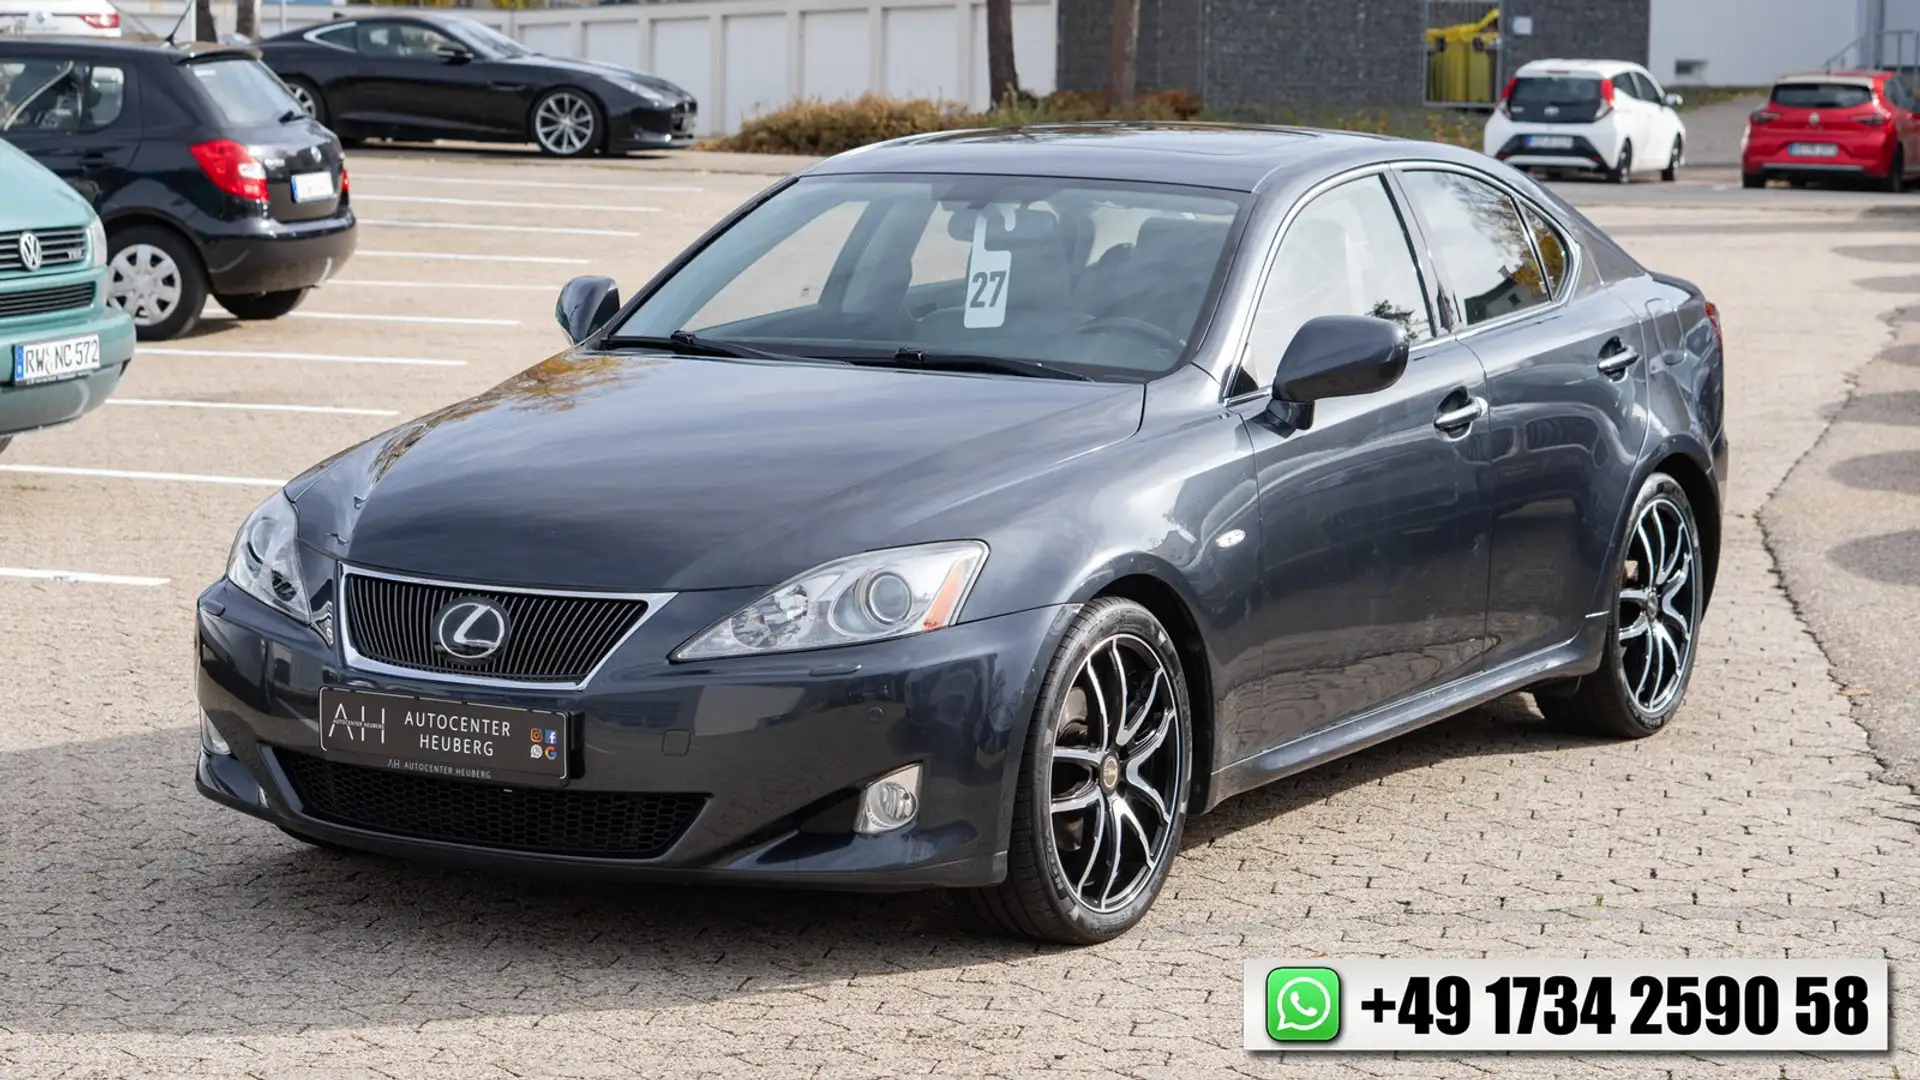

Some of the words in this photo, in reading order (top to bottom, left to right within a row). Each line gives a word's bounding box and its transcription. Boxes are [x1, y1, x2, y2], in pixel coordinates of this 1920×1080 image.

[969, 270, 1007, 309] 27
[25, 347, 46, 374] RW
[54, 343, 72, 367] NC
[75, 339, 99, 365] 572
[328, 702, 386, 744] AH
[404, 710, 511, 737] AUTOCENTER
[419, 733, 494, 757] HEUBERG
[387, 758, 401, 769] AH
[403, 761, 454, 775] AUTOCENTER
[455, 767, 492, 780] HEUBERG
